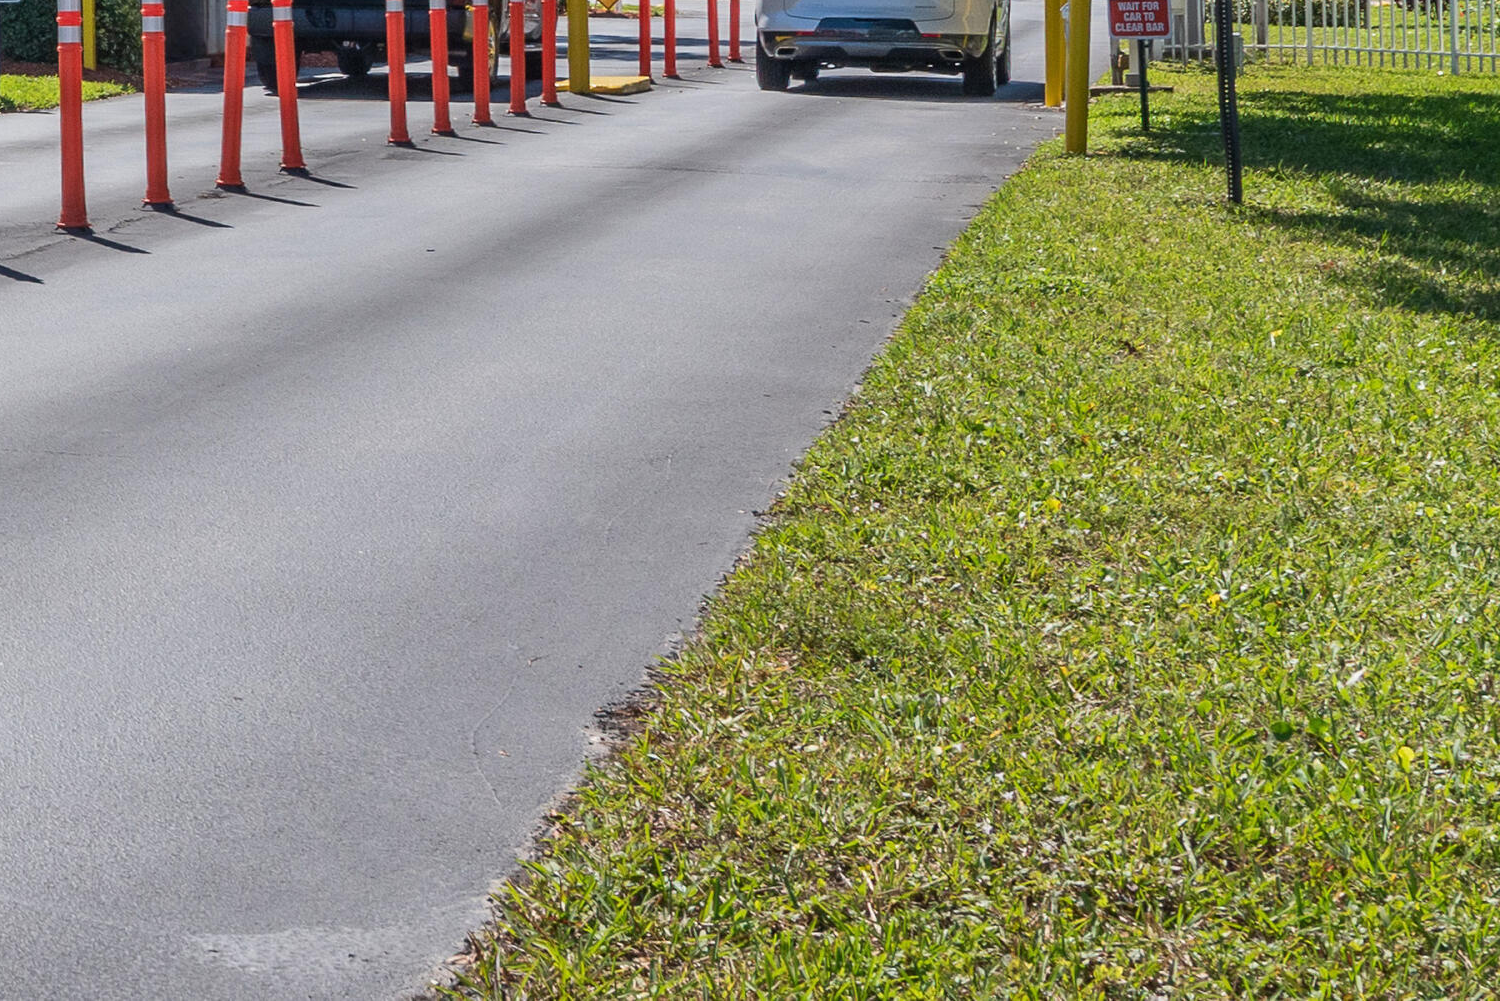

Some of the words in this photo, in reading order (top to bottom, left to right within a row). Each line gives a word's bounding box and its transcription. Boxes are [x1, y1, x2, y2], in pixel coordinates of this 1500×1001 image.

[1117, 1, 1140, 11] WAIT
[1142, 1, 1159, 10] FOR
[1124, 12, 1141, 21] CAR
[1143, 12, 1155, 21] TO
[1115, 23, 1143, 32] CLEAR
[1146, 22, 1164, 32] BAR
